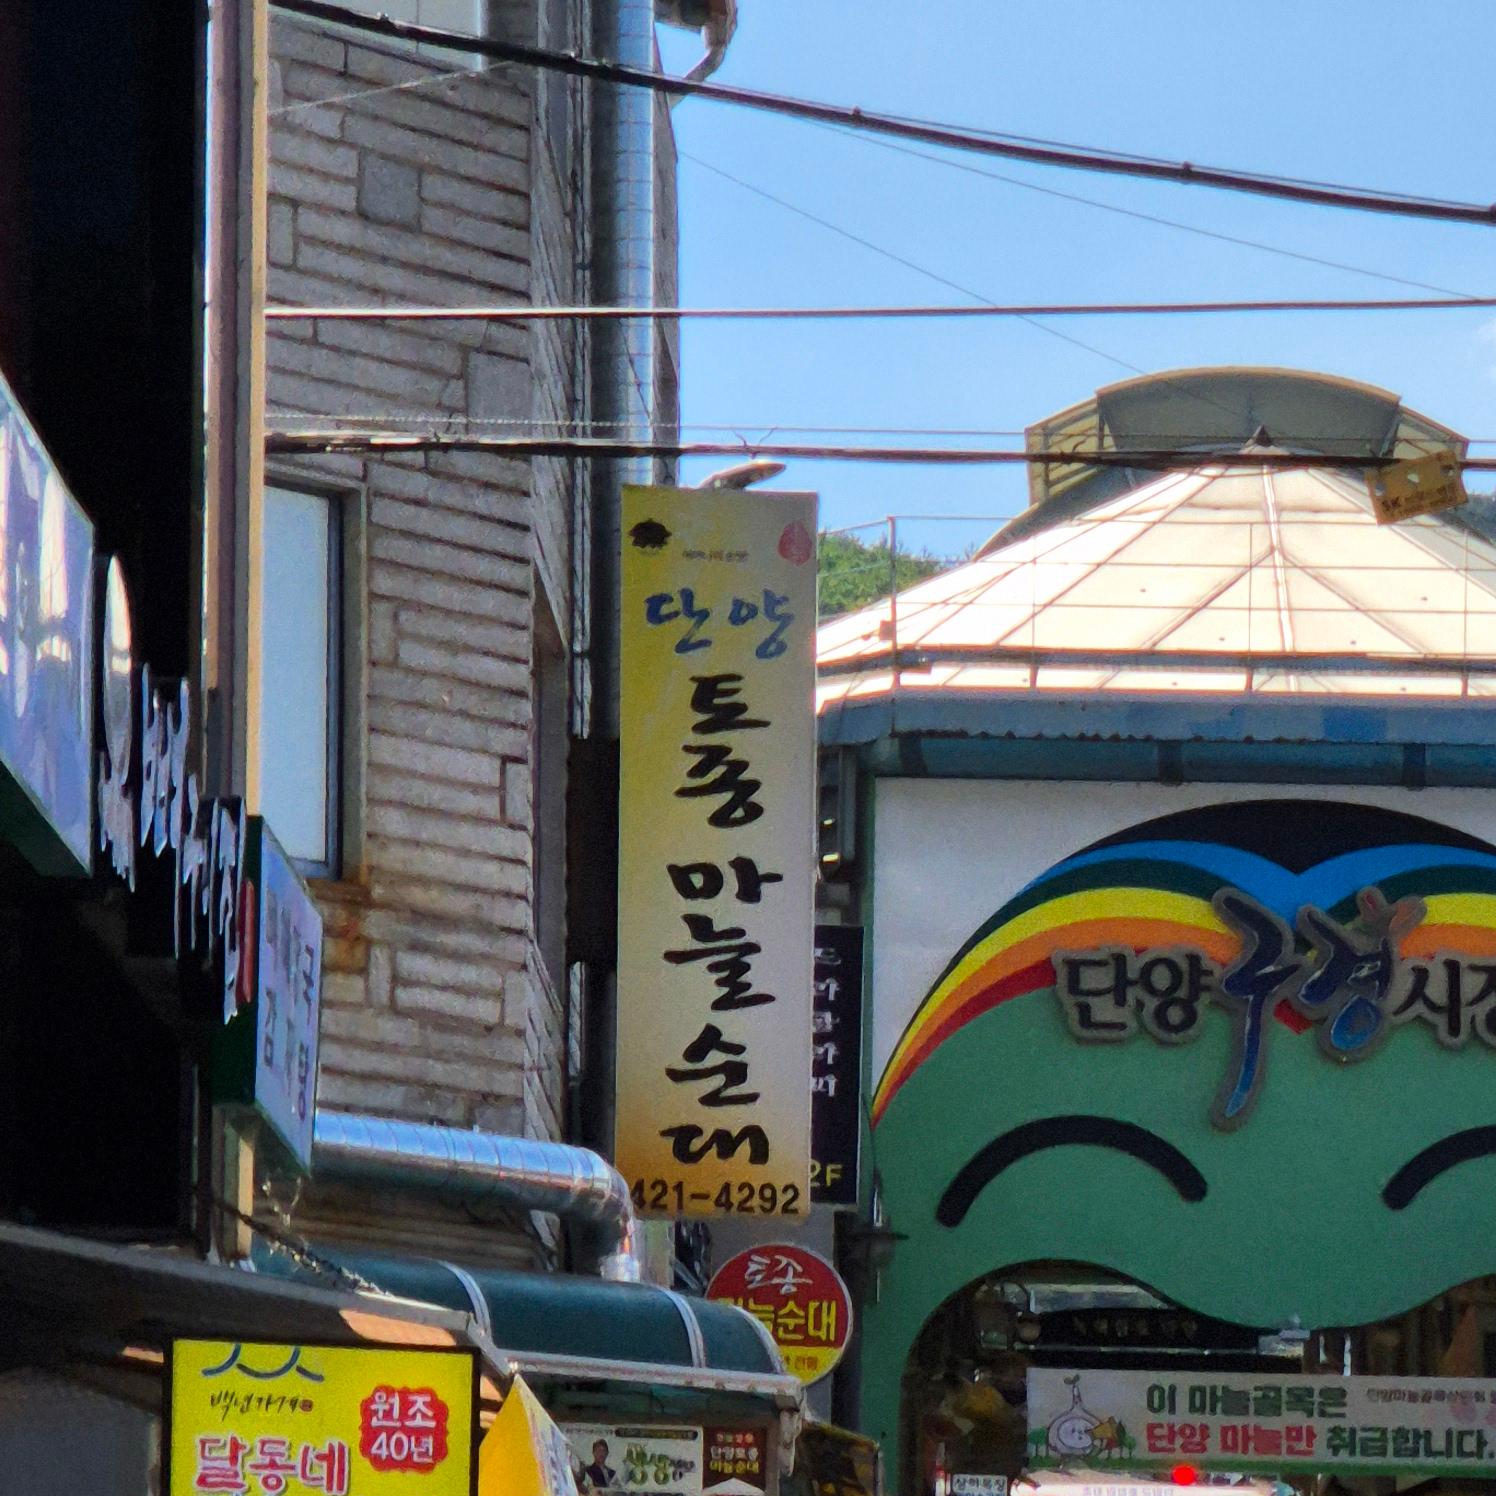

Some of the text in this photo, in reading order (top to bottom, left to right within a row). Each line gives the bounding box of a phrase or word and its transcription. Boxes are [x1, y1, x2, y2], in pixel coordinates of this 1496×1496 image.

[645, 588, 796, 659] 단양
[673, 673, 771, 829] 토종
[660, 856, 784, 1165] 마늘순대
[631, 1179, 800, 1215] 421-4292
[745, 1255, 813, 1295] 토종
[717, 1297, 837, 1342] 늘순대
[370, 1390, 437, 1428] 원조
[1146, 1383, 1347, 1418] 이 마늘골목은
[370, 1432, 435, 1463] 40년
[1146, 1422, 1496, 1460] 단양 마늘만 취급합니다.
[196, 1436, 348, 1495] 달동네
